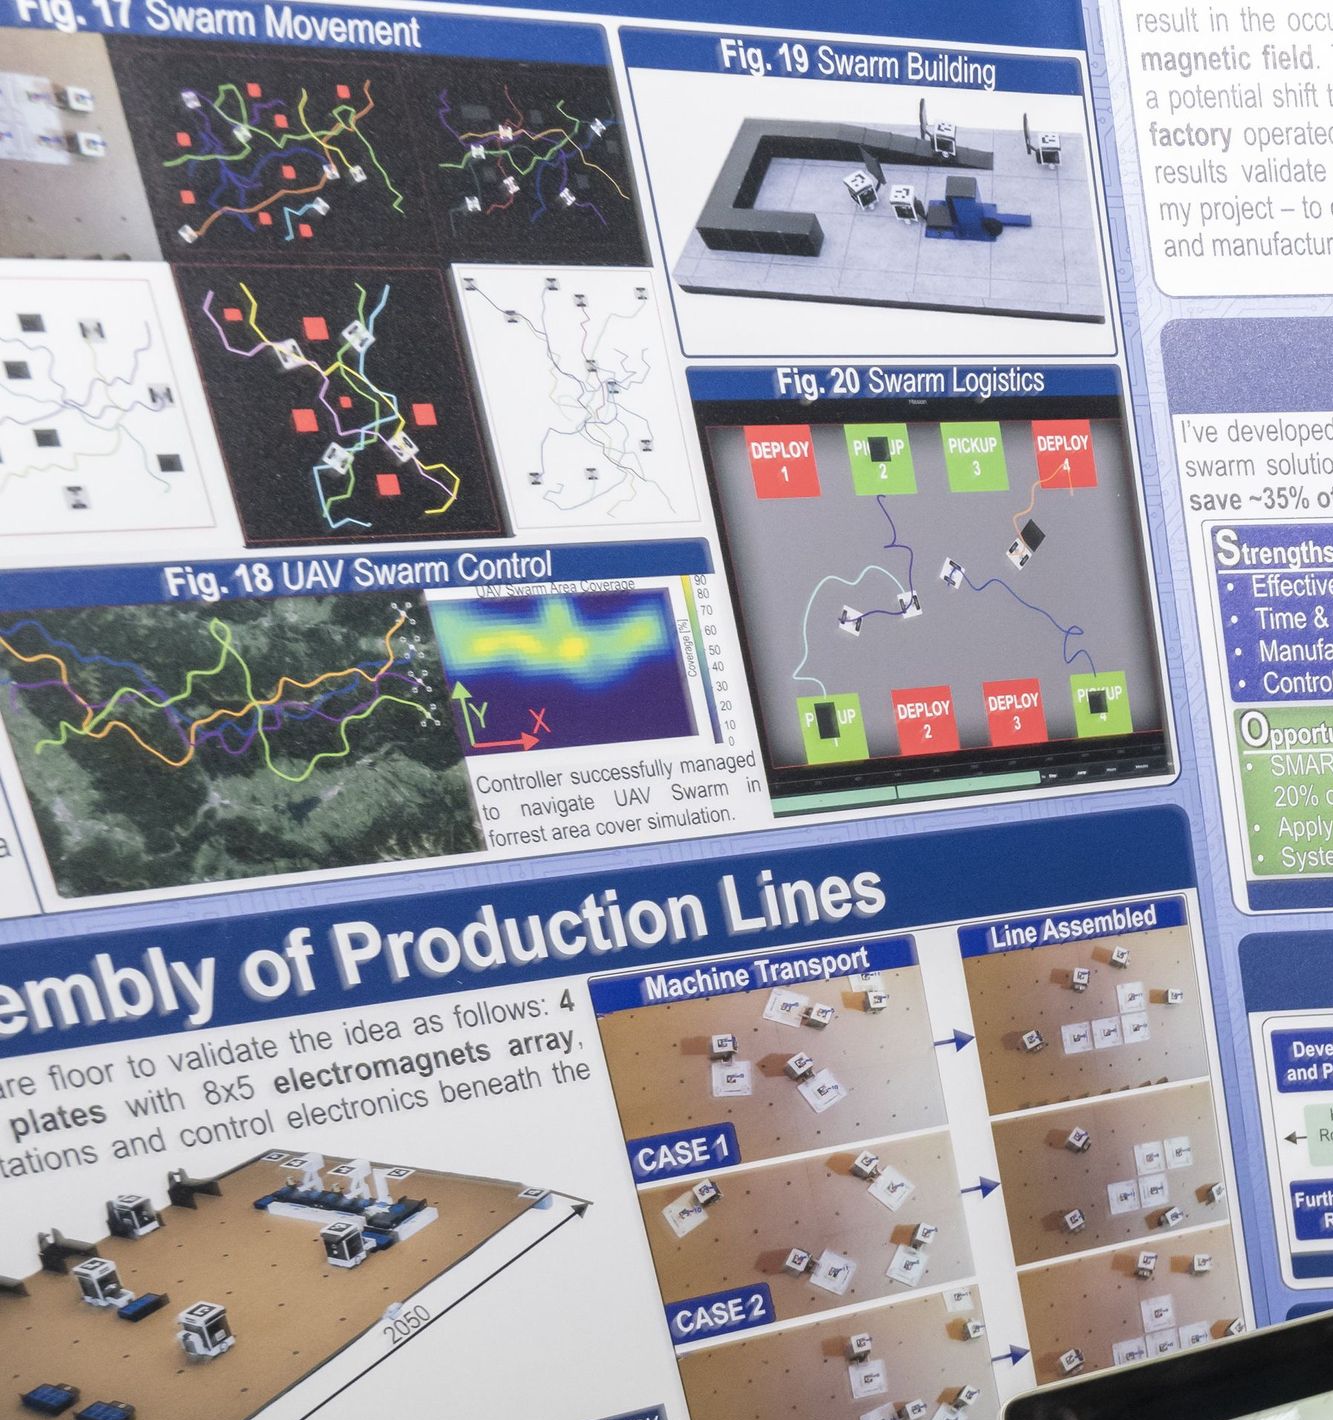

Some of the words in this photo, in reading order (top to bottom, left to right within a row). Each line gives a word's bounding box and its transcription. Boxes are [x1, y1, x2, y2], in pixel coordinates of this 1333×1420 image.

[17, 0, 86, 33] Fig.
[105, 0, 132, 28] 17
[146, 5, 256, 37] Swarm
[264, 13, 422, 48] Movement
[720, 37, 772, 76] Fig.
[779, 44, 808, 73] 19
[818, 46, 899, 79] Swarm
[908, 52, 996, 91] Building
[1141, 46, 1250, 77] magnetic
[1262, 44, 1320, 71] field.
[777, 368, 825, 399] Fig.
[831, 369, 860, 393] 20
[868, 367, 945, 393] Swarm
[952, 367, 1044, 398] Logistics
[751, 441, 809, 460] DEPLOY
[853, 440, 904, 456] PIUP
[948, 438, 997, 454] PICKUP
[1037, 435, 1089, 452] DEPLOY
[781, 466, 789, 482] 1
[879, 464, 888, 479] 2
[973, 461, 982, 477] 3
[1062, 458, 1071, 472] 4
[1190, 489, 1242, 511] save
[1249, 487, 1309, 510] ~35%
[164, 565, 229, 603] Fig.
[233, 564, 273, 595] 18
[283, 559, 343, 592] UAV
[353, 556, 450, 588] Swarm
[457, 550, 552, 582] Control
[468, 702, 488, 728] Y
[529, 708, 551, 734] X
[476, 771, 562, 794] Controller
[571, 759, 672, 786] successfully
[680, 751, 756, 775] managed
[243, 930, 315, 1002] of
[329, 891, 708, 987] Production
[724, 866, 887, 933] Lines
[991, 922, 1038, 951] Line
[1043, 904, 1157, 943] Assembled
[645, 965, 748, 1001] Machine
[754, 946, 871, 989] Transport
[9, 1103, 107, 1143] plates
[124, 1087, 186, 1118] with
[203, 1074, 254, 1105] 8x5
[274, 1040, 491, 1094] electromagnets
[509, 1029, 583, 1057] array,
[1287, 1064, 1318, 1081] and
[637, 1138, 711, 1175] CASE
[717, 1134, 730, 1159] 1
[383, 1302, 431, 1347] 2050
[676, 1300, 746, 1334] CASE
[752, 1294, 766, 1319] 2
